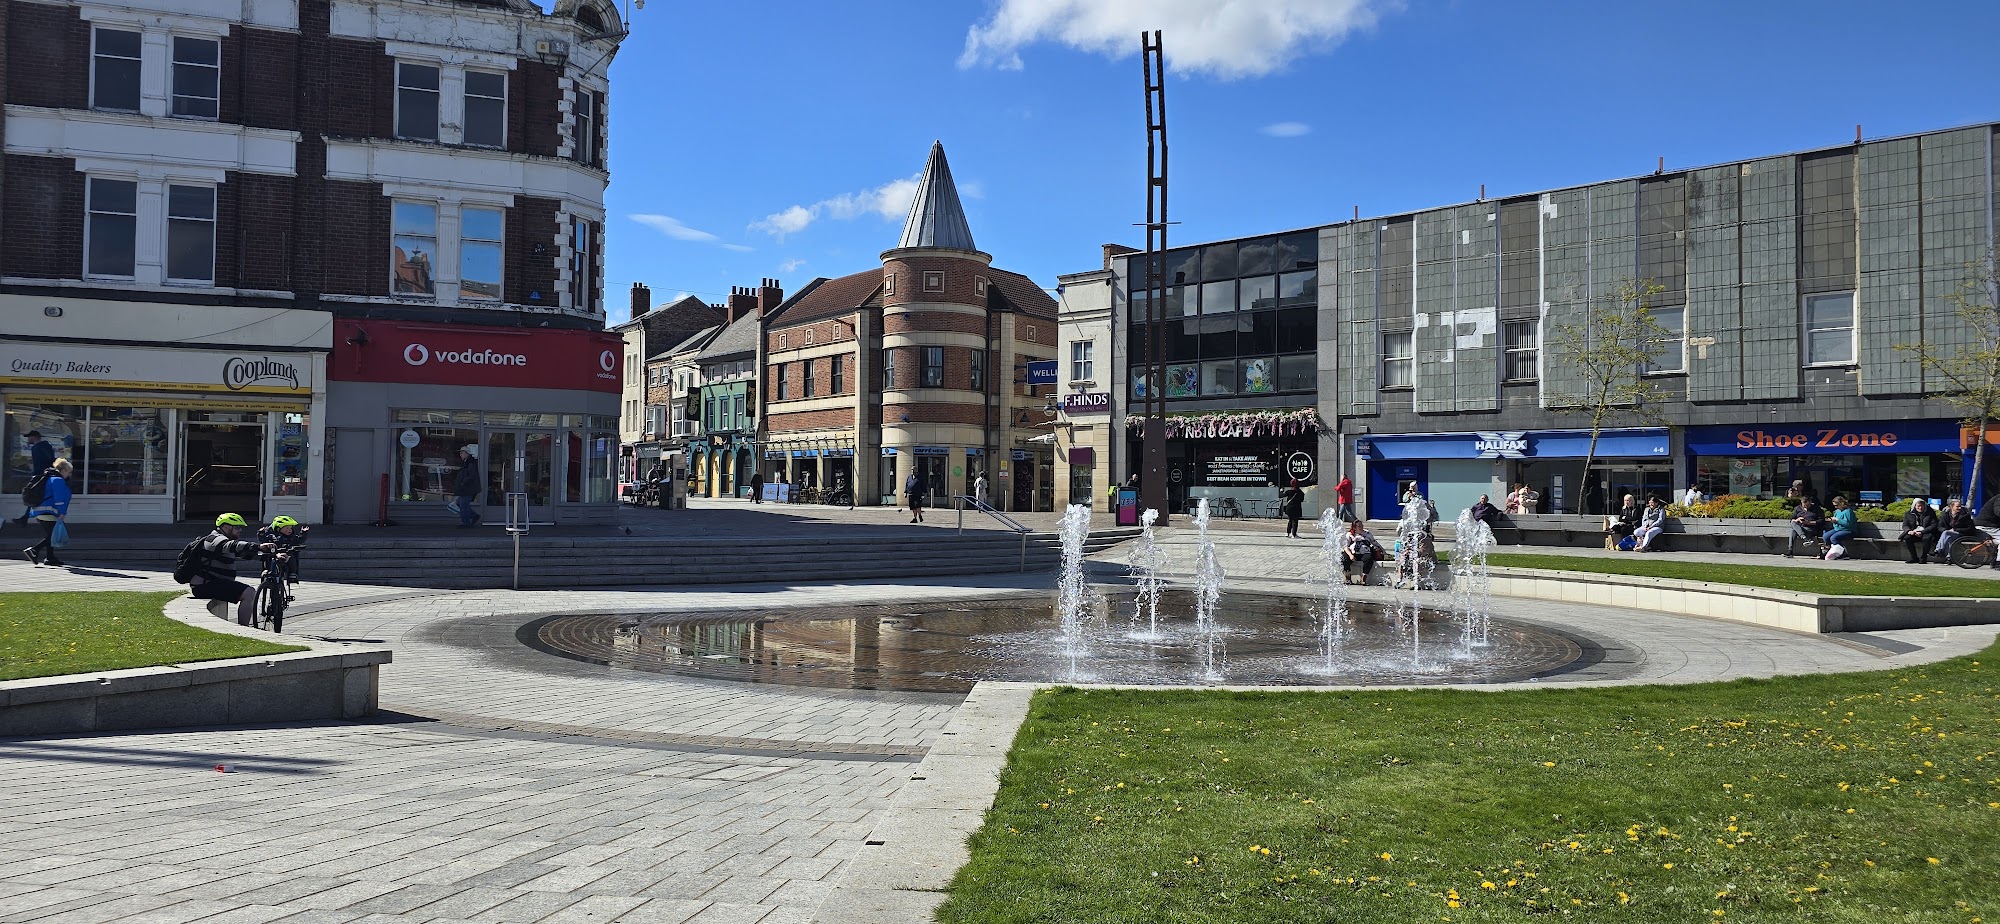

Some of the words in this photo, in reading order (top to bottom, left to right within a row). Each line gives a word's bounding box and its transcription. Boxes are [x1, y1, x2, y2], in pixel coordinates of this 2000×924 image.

[435, 349, 527, 366] vodafone
[10, 359, 62, 375] Quality
[66, 361, 112, 374] Bakers
[223, 356, 299, 391] Cooplands
[597, 372, 616, 380] vodafone
[1064, 394, 1108, 406] F.HINDS
[1475, 439, 1528, 450] HALIFAX
[1736, 430, 1808, 449] Shoe
[1815, 429, 1898, 448] Zone
[1121, 497, 1135, 506] YES
